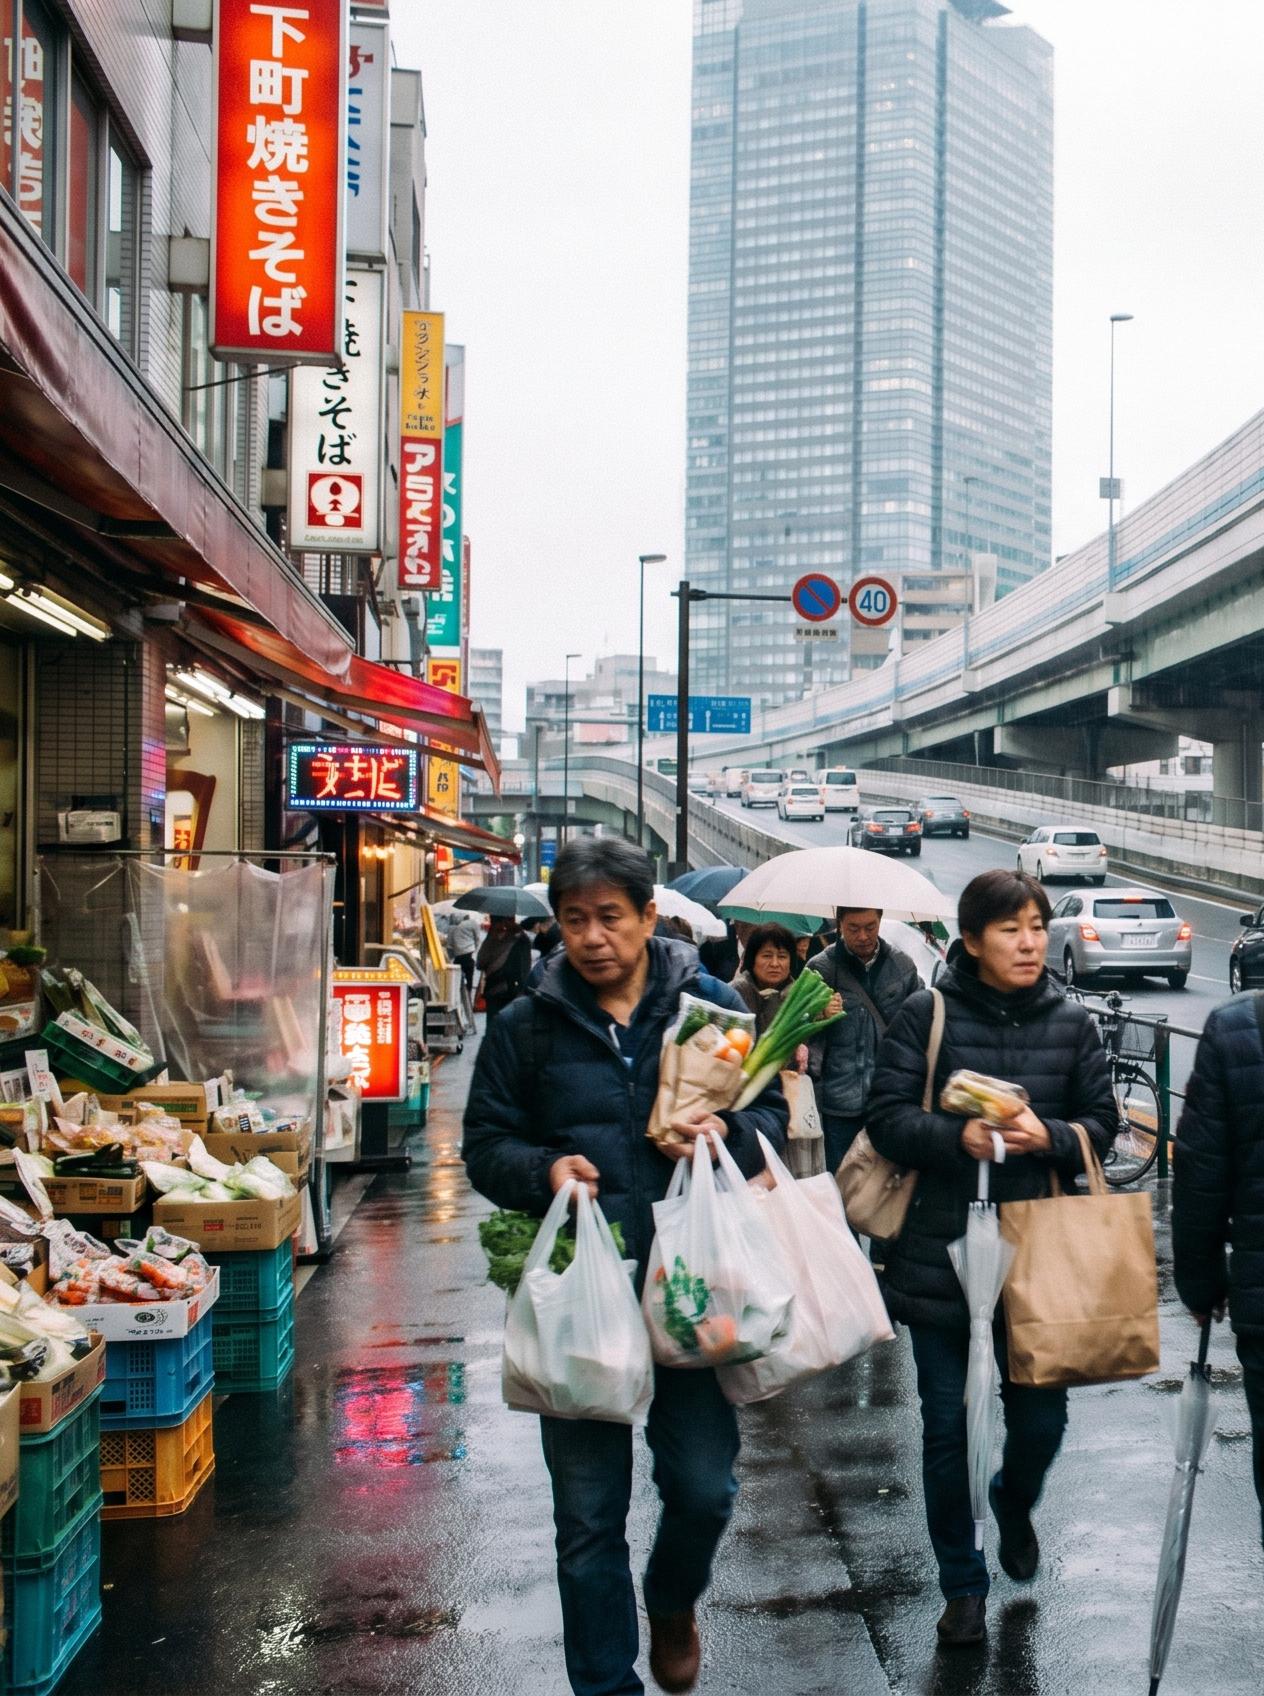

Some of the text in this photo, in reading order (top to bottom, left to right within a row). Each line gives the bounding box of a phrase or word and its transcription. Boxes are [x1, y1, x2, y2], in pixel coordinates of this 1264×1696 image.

[247, 4, 310, 337] 下町焼きそば
[859, 590, 887, 613] 40
